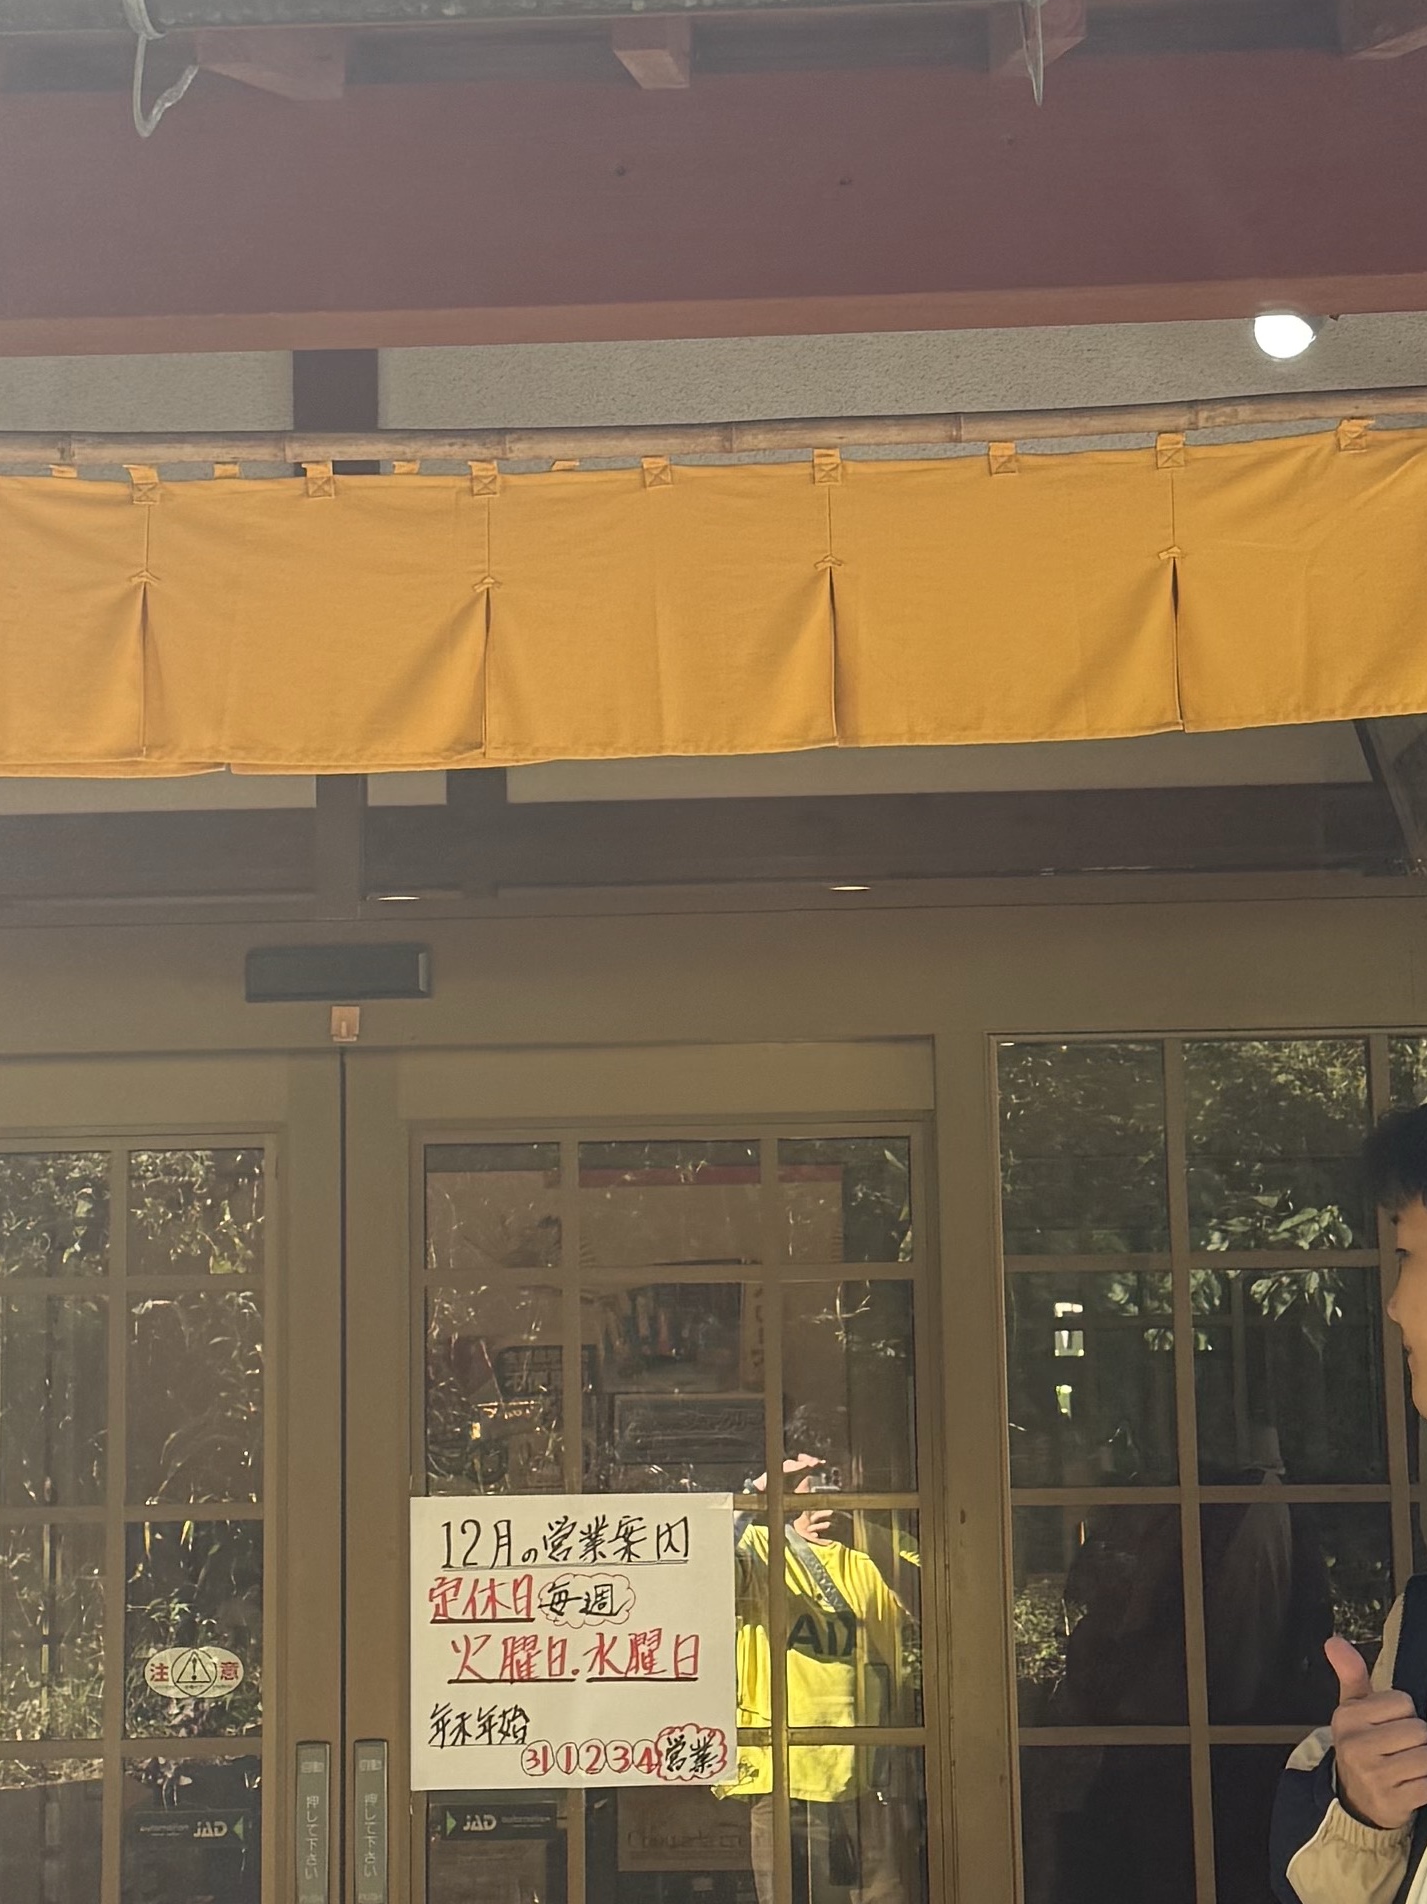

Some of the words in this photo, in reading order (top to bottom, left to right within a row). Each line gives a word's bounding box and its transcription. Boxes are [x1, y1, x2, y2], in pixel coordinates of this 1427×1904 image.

[429, 1574, 534, 1620] 定休日
[538, 1582, 619, 1616] 毎週
[429, 1702, 531, 1745] 年末年始
[665, 1734, 718, 1773] 営業
